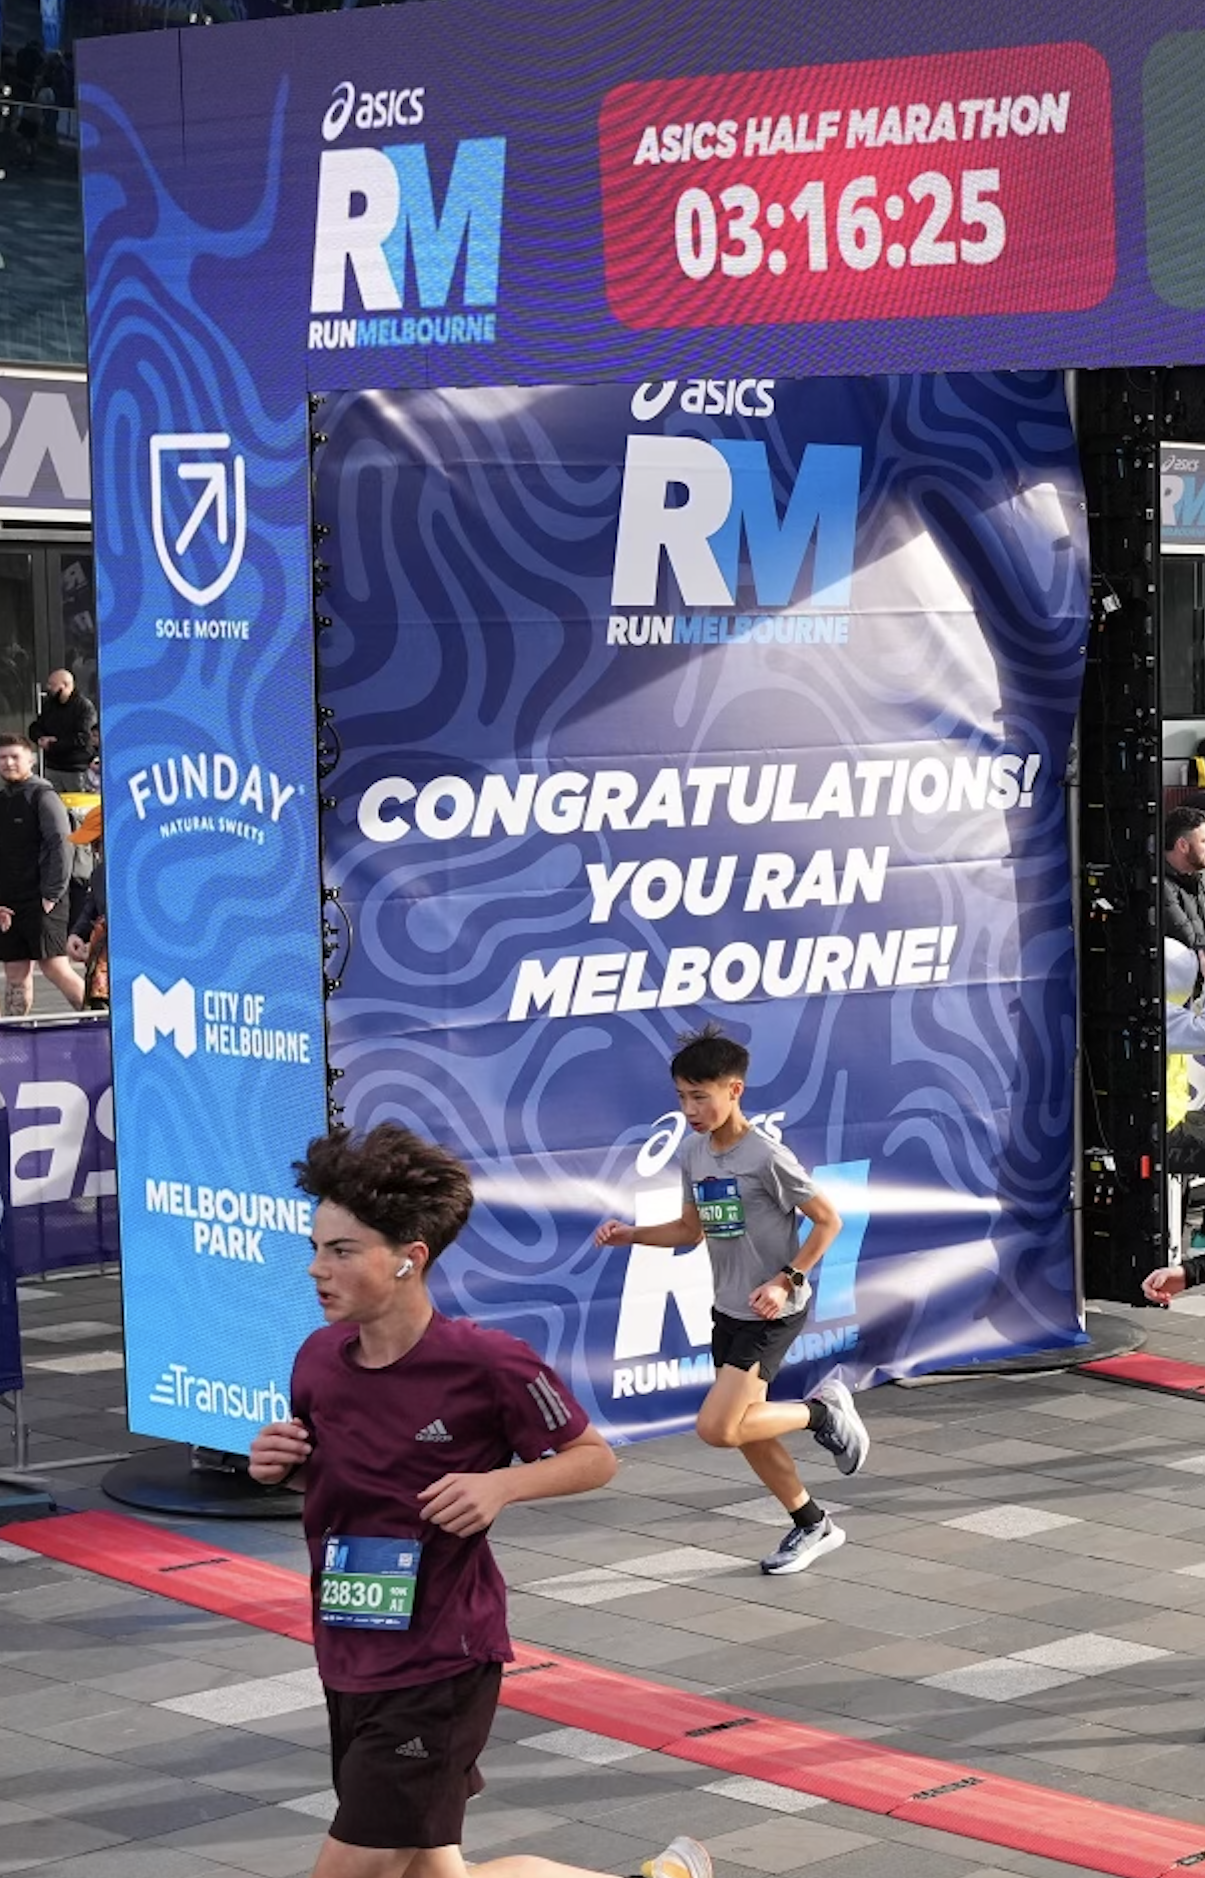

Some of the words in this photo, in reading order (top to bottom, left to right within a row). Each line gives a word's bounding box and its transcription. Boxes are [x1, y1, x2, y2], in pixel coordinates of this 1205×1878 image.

[355, 87, 425, 129] asics
[633, 120, 738, 165] ASICS
[743, 107, 842, 158] HALF
[846, 91, 1071, 150] MARATHON
[310, 135, 507, 314] RM
[675, 168, 1006, 280] 03:16:25
[308, 313, 498, 350] RUNMELBOURNE
[611, 434, 863, 607] RM
[155, 618, 190, 639] SOLE
[194, 619, 250, 640] MOTIVE
[606, 615, 851, 646] RUNMELBOURNE
[128, 752, 296, 823] FUNDAY
[356, 754, 1042, 843] CONGRATULATIONS!
[159, 816, 216, 838] NATURAL
[217, 816, 266, 845] SWEETS
[586, 856, 738, 924] YOU
[742, 846, 890, 913] RAN
[507, 925, 959, 1022] MELBOURNE!
[203, 989, 239, 1023] CITY
[243, 994, 266, 1026] OF
[204, 1022, 311, 1064] MELBOURNE
[144, 1178, 313, 1238] MELBOURNE
[193, 1220, 266, 1265] PARK
[168, 1363, 293, 1423] Transurb
[322, 1579, 384, 1608] 23830
